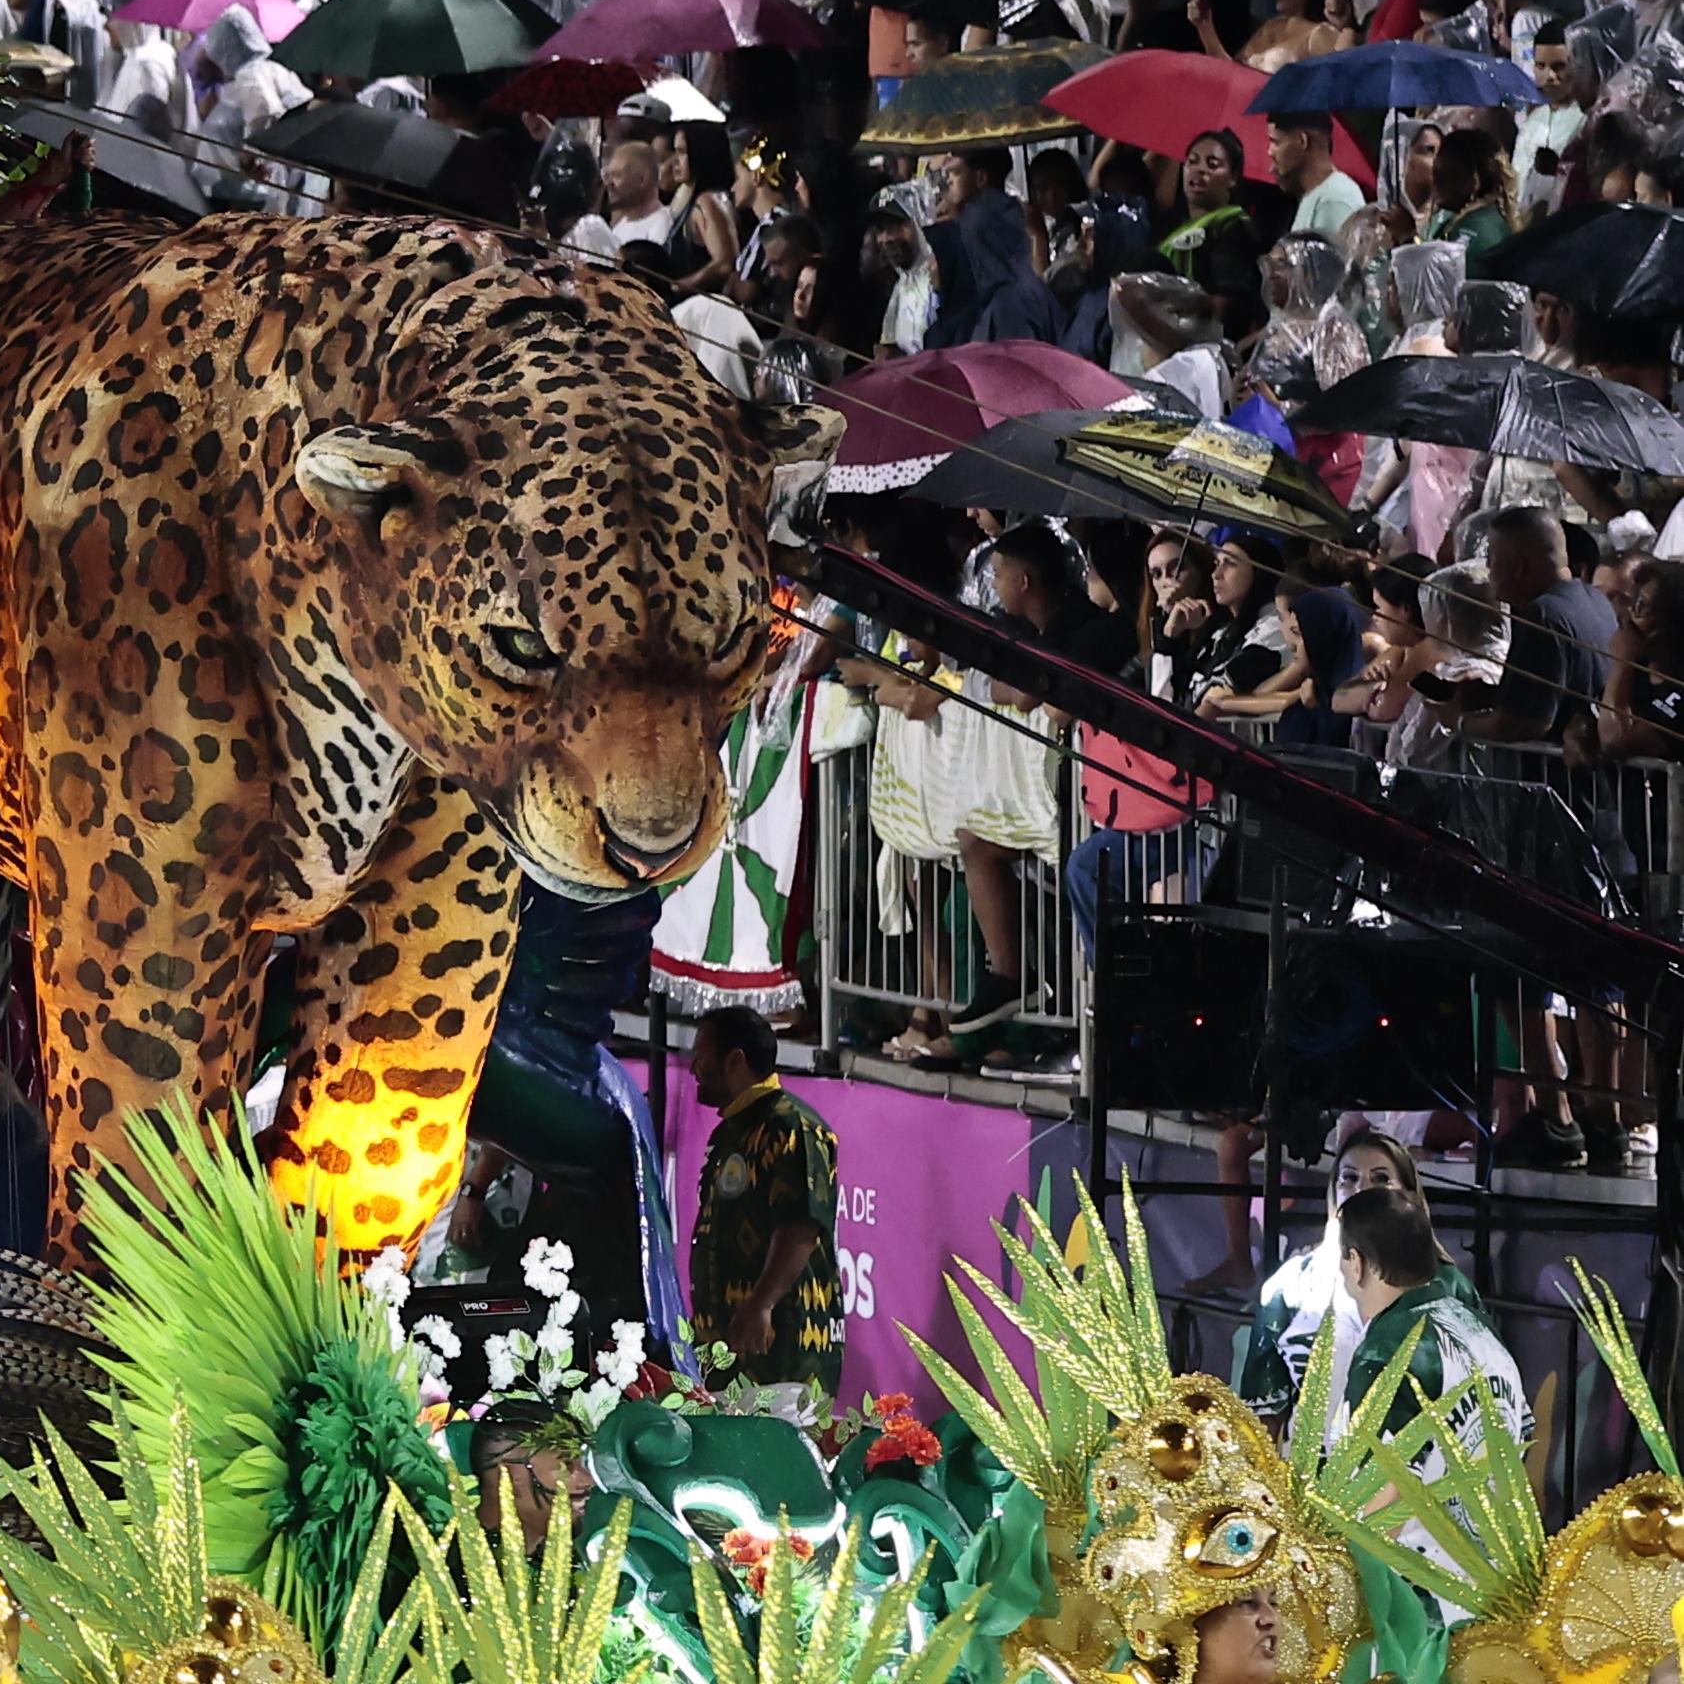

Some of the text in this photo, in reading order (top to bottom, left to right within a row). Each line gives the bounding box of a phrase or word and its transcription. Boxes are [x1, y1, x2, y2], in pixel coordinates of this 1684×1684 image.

[852, 1186, 877, 1225] DE
[836, 1247, 875, 1320] OS
[464, 1301, 489, 1311] PRO
